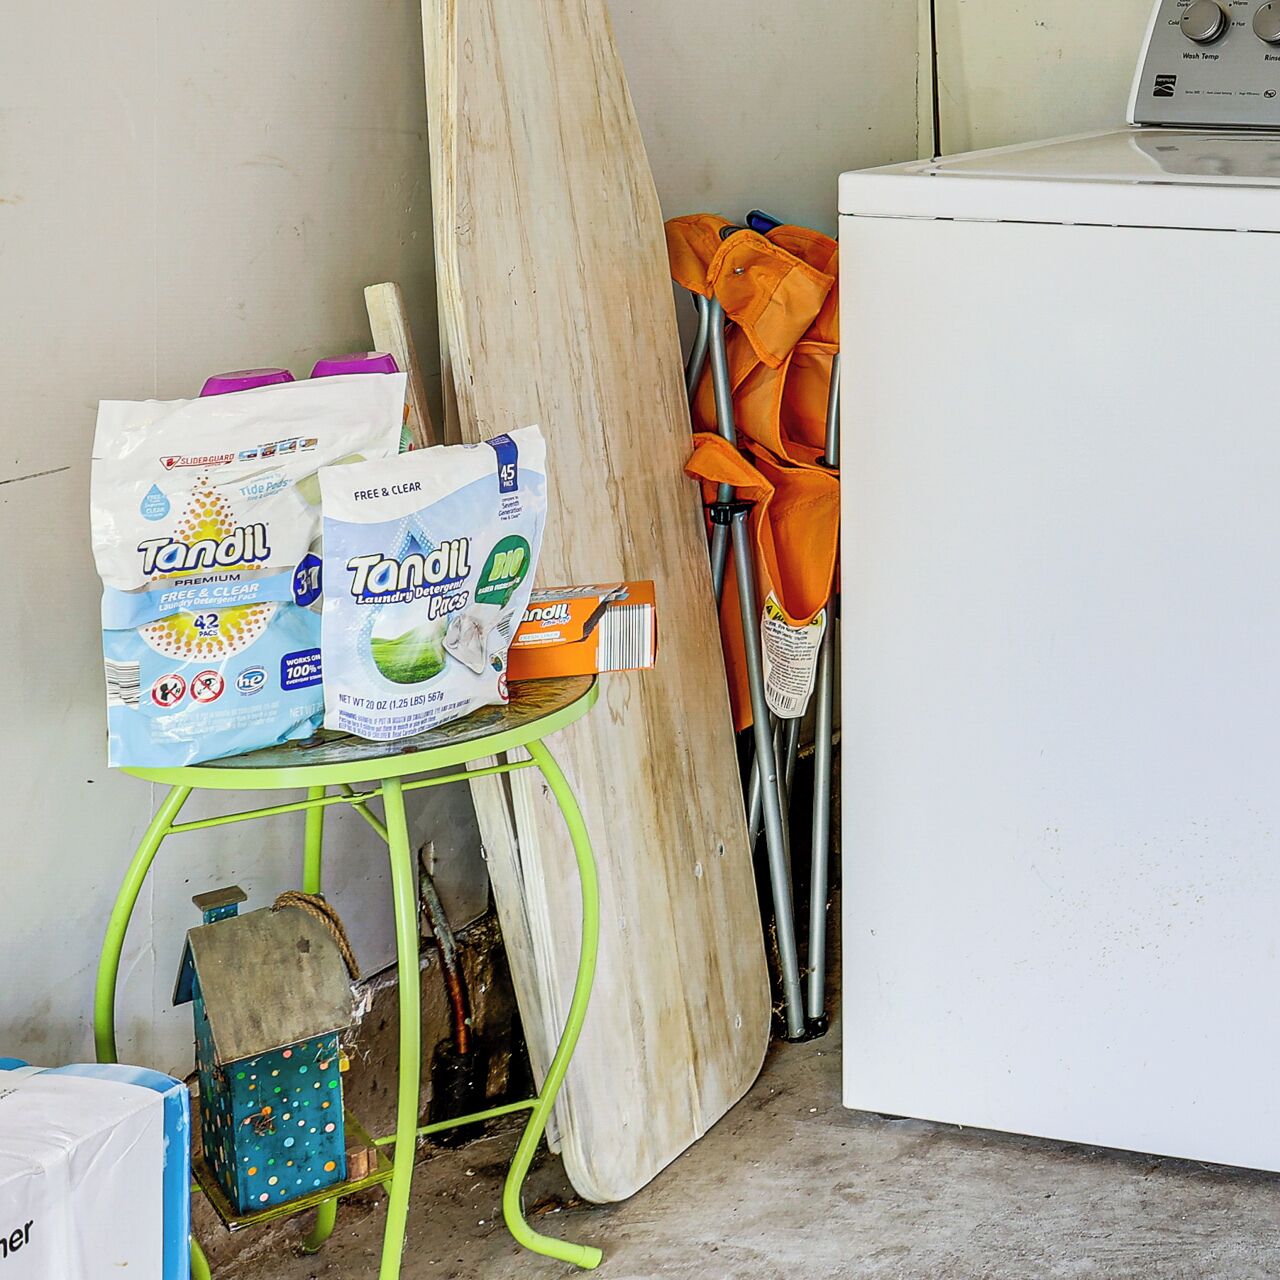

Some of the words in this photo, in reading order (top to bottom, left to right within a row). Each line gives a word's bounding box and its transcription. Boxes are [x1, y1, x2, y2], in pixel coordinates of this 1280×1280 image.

[1201, 53, 1219, 61] Temp
[500, 463, 515, 481] 45
[239, 484, 264, 496] Tide
[354, 489, 381, 501] FREE
[381, 487, 390, 497] &
[391, 482, 421, 495] CLEAR
[137, 522, 271, 575] Tandil
[346, 537, 471, 596] Tandil
[174, 574, 241, 587] PREMIUM
[160, 589, 195, 603] FREE
[198, 588, 209, 598] &
[213, 583, 260, 596] CLEAR
[356, 591, 414, 605] Laundry
[415, 579, 464, 599] Detergent
[159, 599, 193, 611] Laundry
[193, 595, 237, 606] Detergent
[428, 591, 469, 621] Pacs
[193, 613, 219, 630] 42
[199, 629, 218, 637] PACS
[286, 655, 311, 666] WORKS
[286, 664, 317, 679] 100%
[237, 674, 264, 690] he
[339, 693, 351, 705] NET
[352, 695, 365, 707] WT
[365, 699, 376, 710] 20
[376, 698, 387, 710] OZ
[389, 695, 408, 711] (1.25
[409, 692, 426, 706] LBS)
